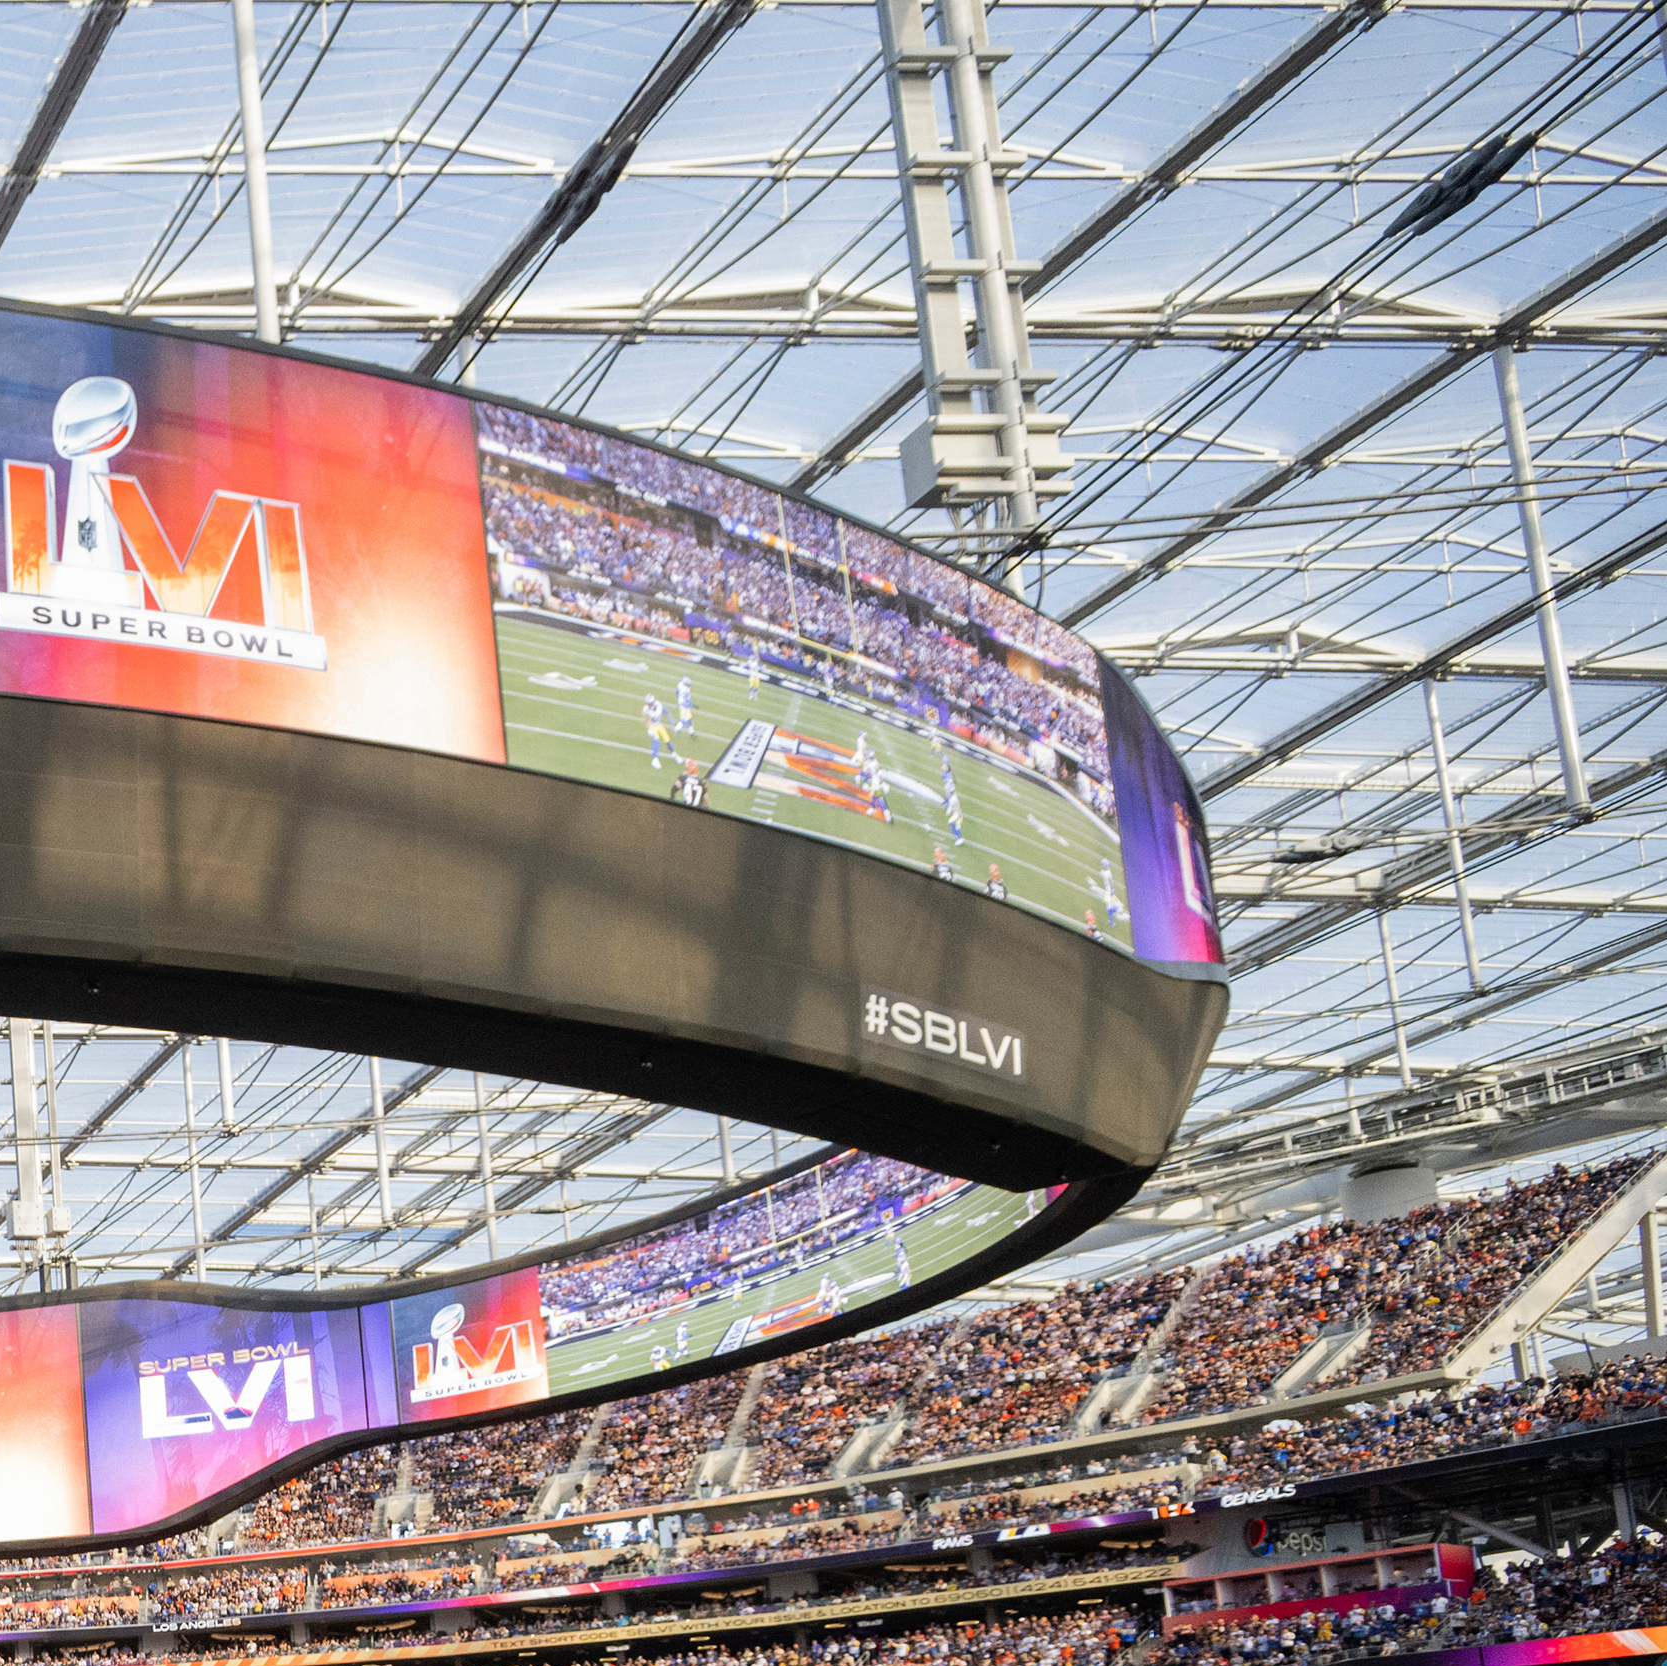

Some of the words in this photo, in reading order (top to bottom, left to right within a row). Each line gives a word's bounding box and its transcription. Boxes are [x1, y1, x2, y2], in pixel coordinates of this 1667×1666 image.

[31, 604, 168, 639] SUPER
[187, 623, 294, 658] BOWL
[864, 994, 1022, 1076] #SBLVI
[139, 1355, 226, 1376] SUPER
[232, 1341, 310, 1364] BOWL
[139, 1354, 316, 1440] LVI
[424, 1381, 478, 1399] SUPER
[483, 1371, 529, 1389] BOWL
[1220, 1484, 1297, 1508] BENGALS
